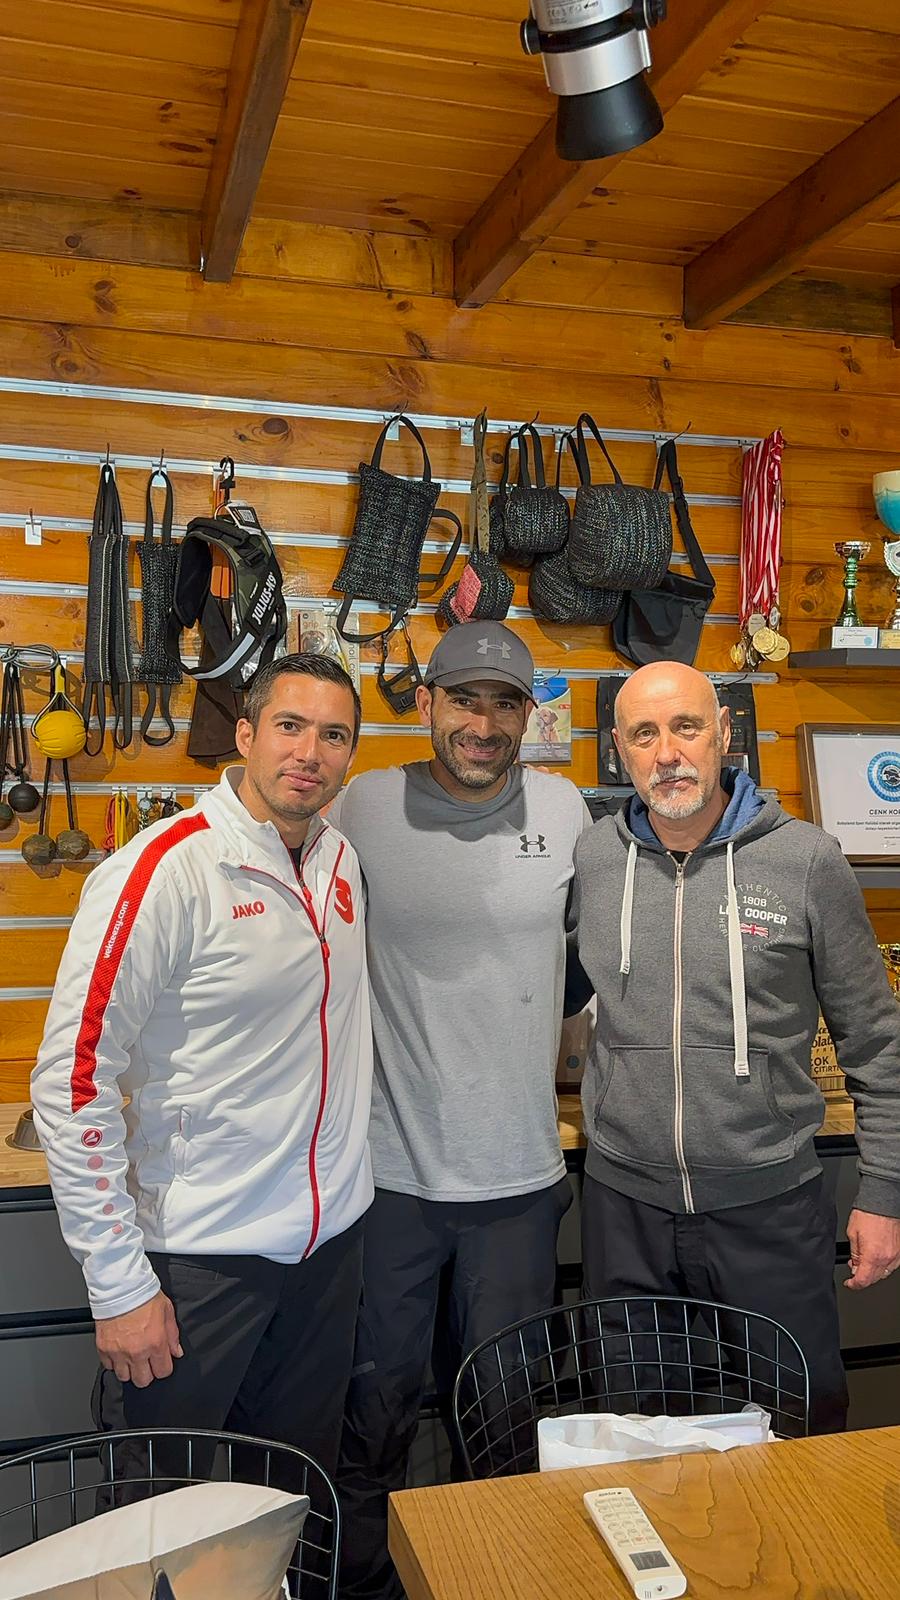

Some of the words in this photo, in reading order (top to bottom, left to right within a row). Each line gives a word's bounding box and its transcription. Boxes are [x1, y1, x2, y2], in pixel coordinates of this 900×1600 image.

[251, 572, 277, 626] JULIUS-K9
[723, 883, 787, 912] ATHENTIC
[742, 895, 767, 907] 1908
[232, 900, 265, 919] JAKO
[744, 907, 788, 925] COOPER
